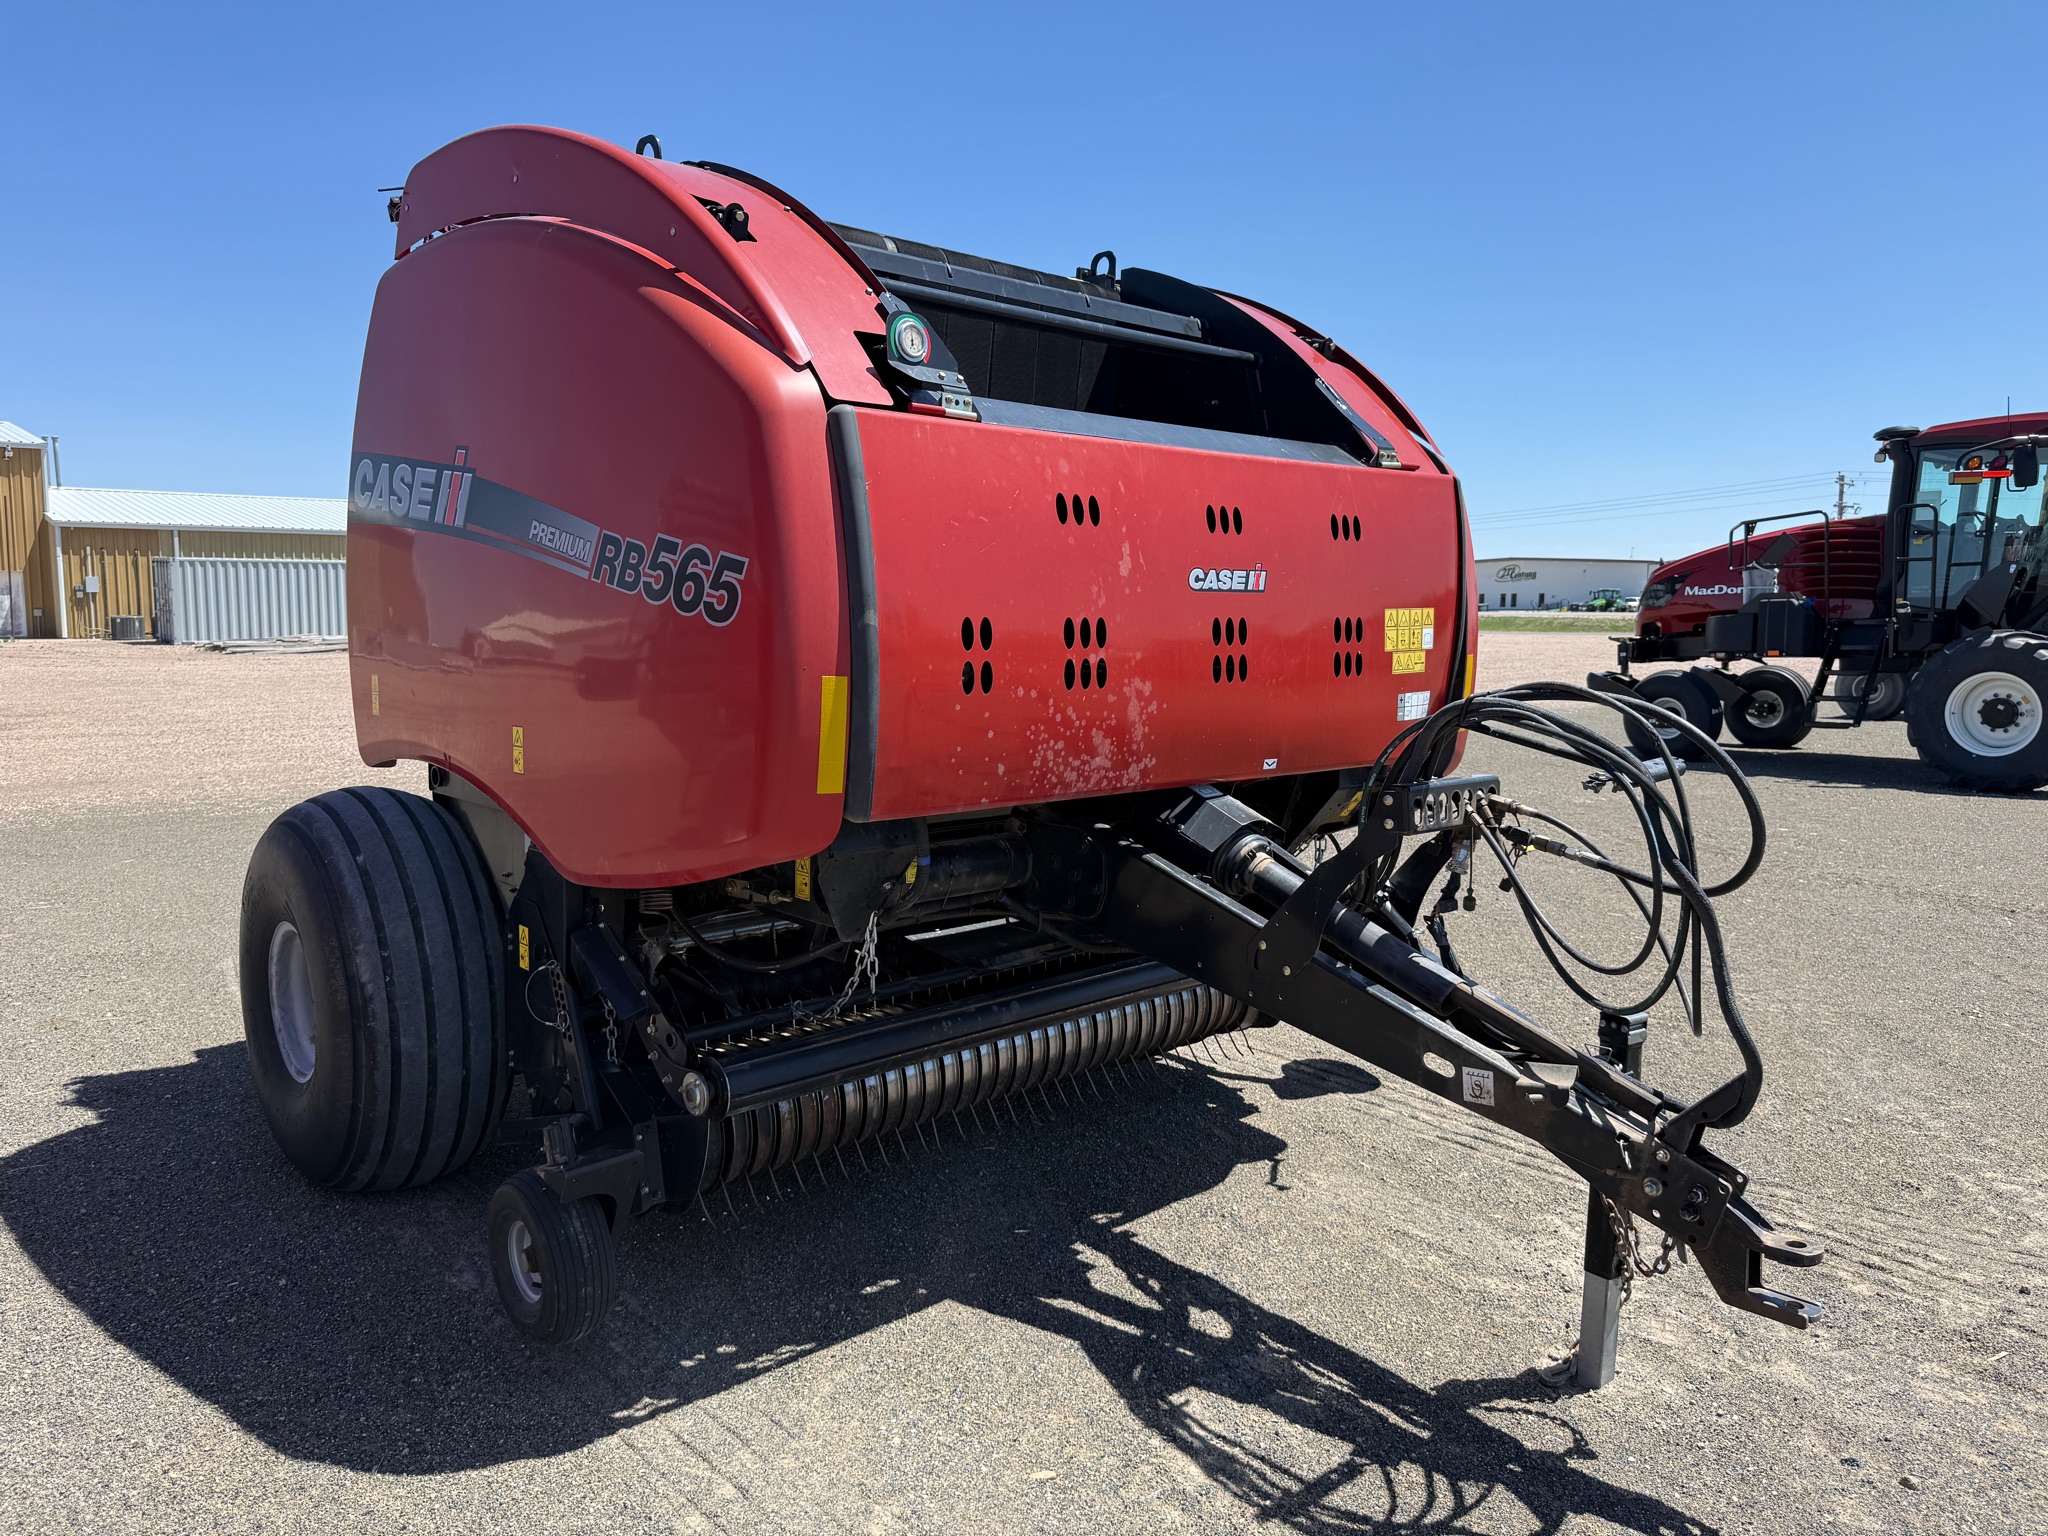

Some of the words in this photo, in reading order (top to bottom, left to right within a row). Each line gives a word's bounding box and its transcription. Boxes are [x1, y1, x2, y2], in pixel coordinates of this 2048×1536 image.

[353, 458, 437, 520] CASE
[528, 519, 592, 563] PREMIUM
[592, 531, 749, 628] RB565
[1188, 567, 1247, 592] CASE
